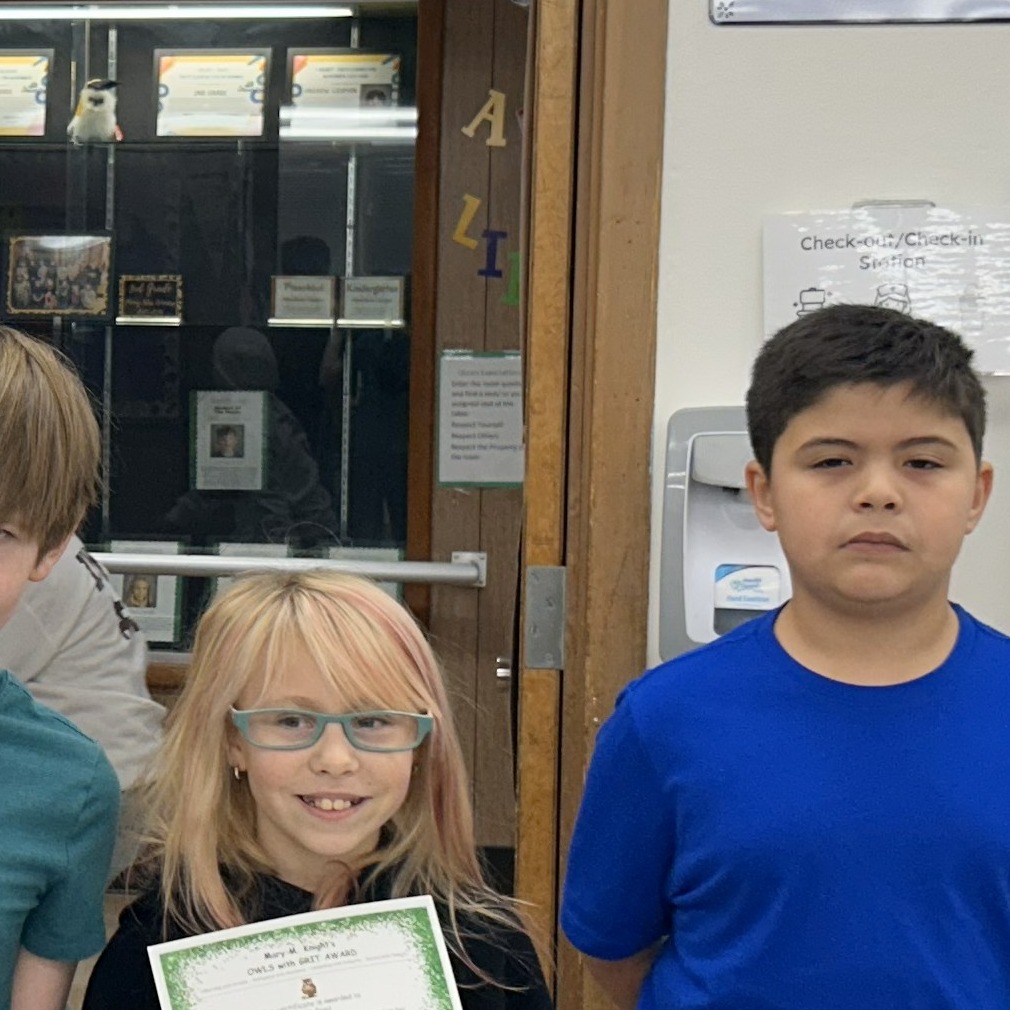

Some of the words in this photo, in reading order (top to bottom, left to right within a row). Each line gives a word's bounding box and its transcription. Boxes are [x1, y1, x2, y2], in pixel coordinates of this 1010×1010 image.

[247, 965, 275, 976] OWLS
[277, 960, 295, 969] with
[298, 956, 320, 966] GRIT
[325, 949, 357, 961] AWARD
[264, 950, 285, 960] Mary
